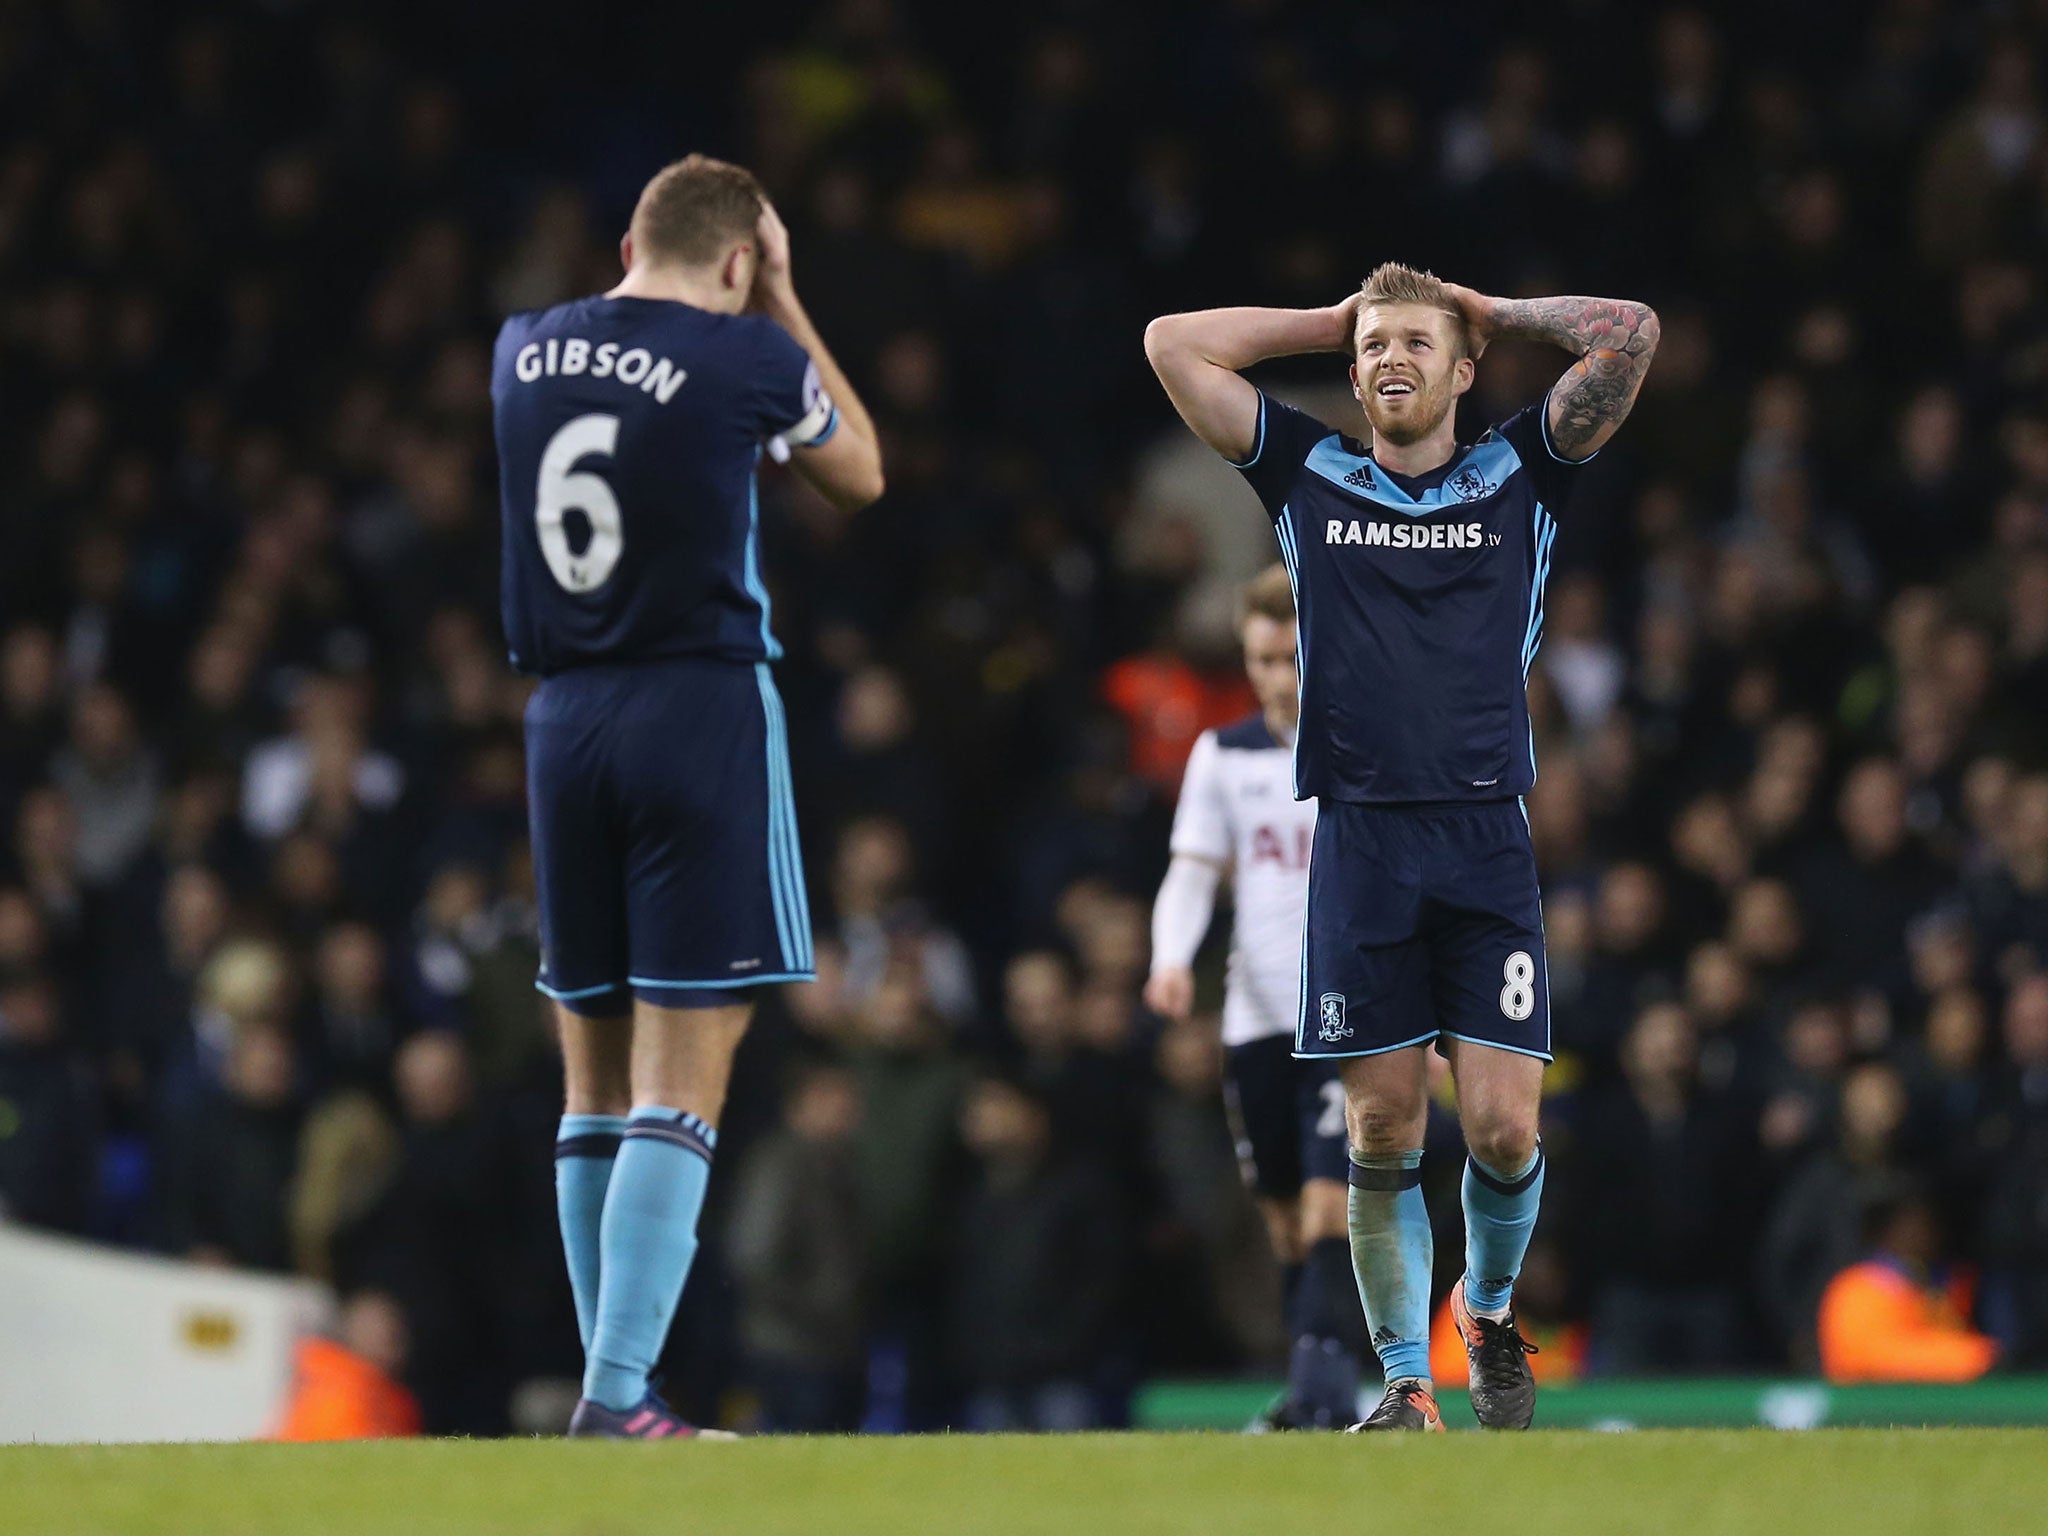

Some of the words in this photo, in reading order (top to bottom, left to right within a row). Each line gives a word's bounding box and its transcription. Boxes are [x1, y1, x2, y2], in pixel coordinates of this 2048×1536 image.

[515, 338, 688, 405] GIBSON
[535, 412, 624, 594] 6
[1343, 473, 1377, 491] adidas
[1499, 950, 1535, 1021] 8
